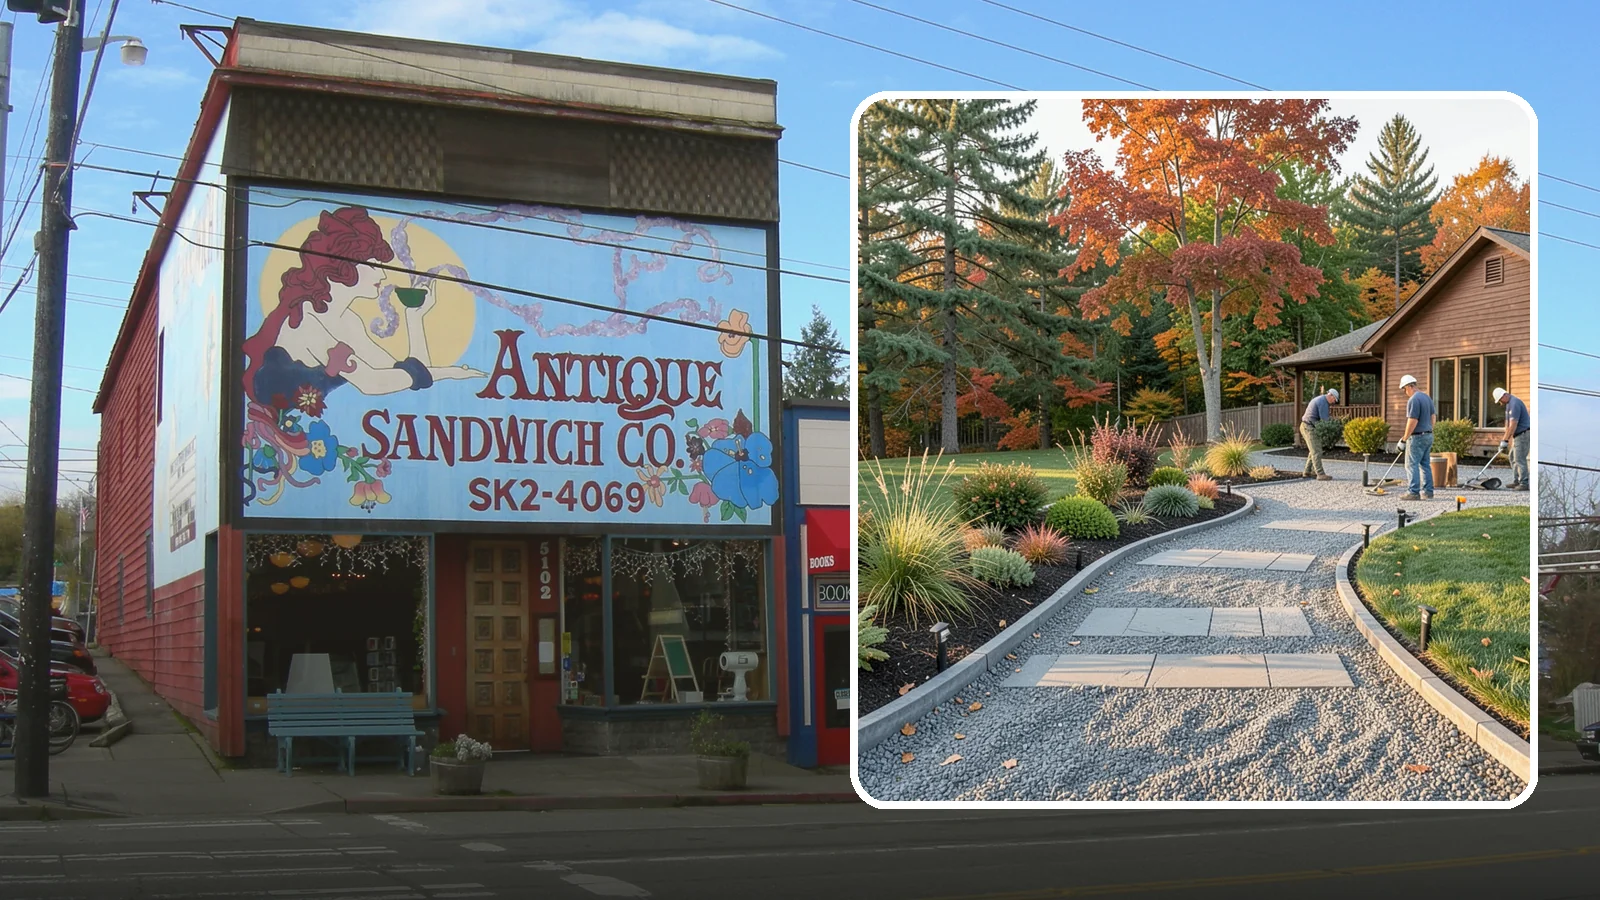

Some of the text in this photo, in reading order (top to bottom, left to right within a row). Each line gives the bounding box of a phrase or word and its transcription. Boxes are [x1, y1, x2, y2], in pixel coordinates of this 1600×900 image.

[476, 329, 724, 421] ANTIQUE
[361, 408, 685, 469] SANDWICH CO.
[468, 477, 646, 514] SK2-4069
[540, 542, 551, 599] 5102
[809, 555, 835, 569] BOOKS
